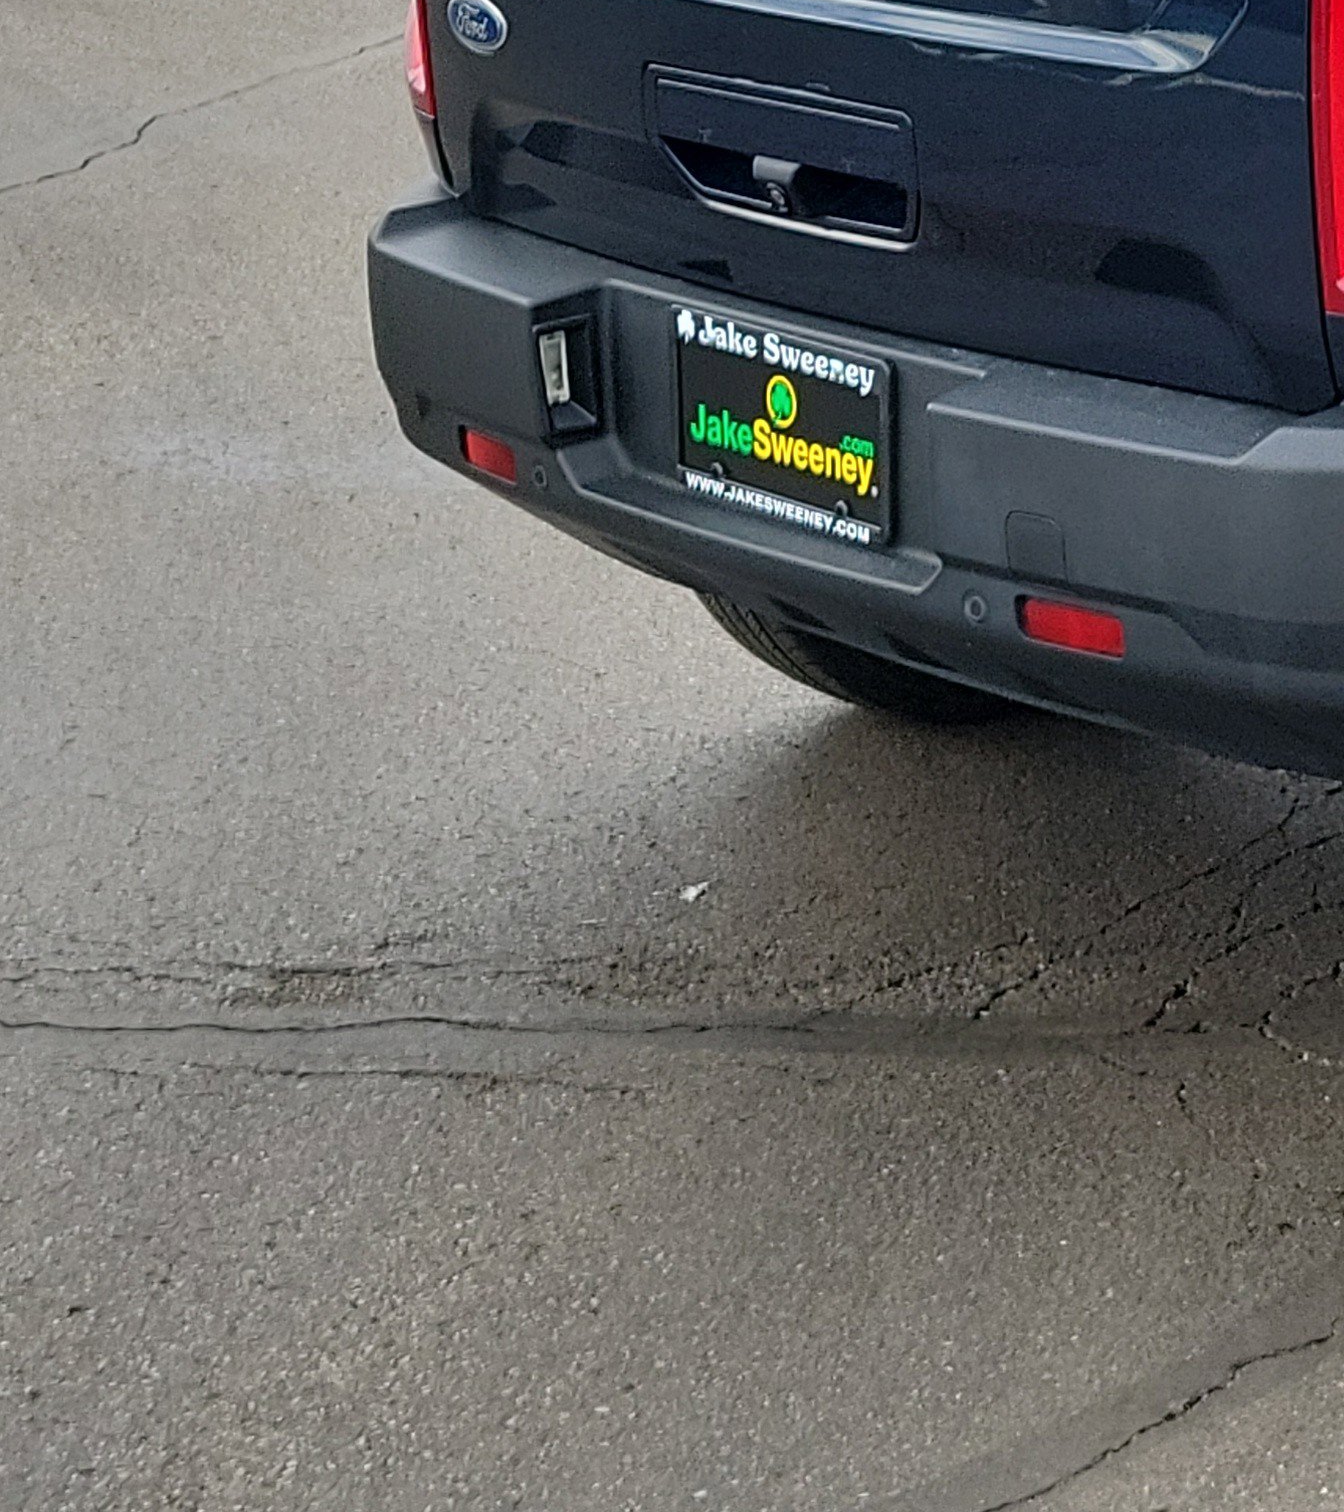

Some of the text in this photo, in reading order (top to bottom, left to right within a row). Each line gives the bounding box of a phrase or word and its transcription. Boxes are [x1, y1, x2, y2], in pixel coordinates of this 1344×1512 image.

[456, 2, 489, 41] Ford
[699, 315, 876, 397] Jake Sweeney
[685, 471, 871, 545] WWW.JAKESWEENEY.COM
